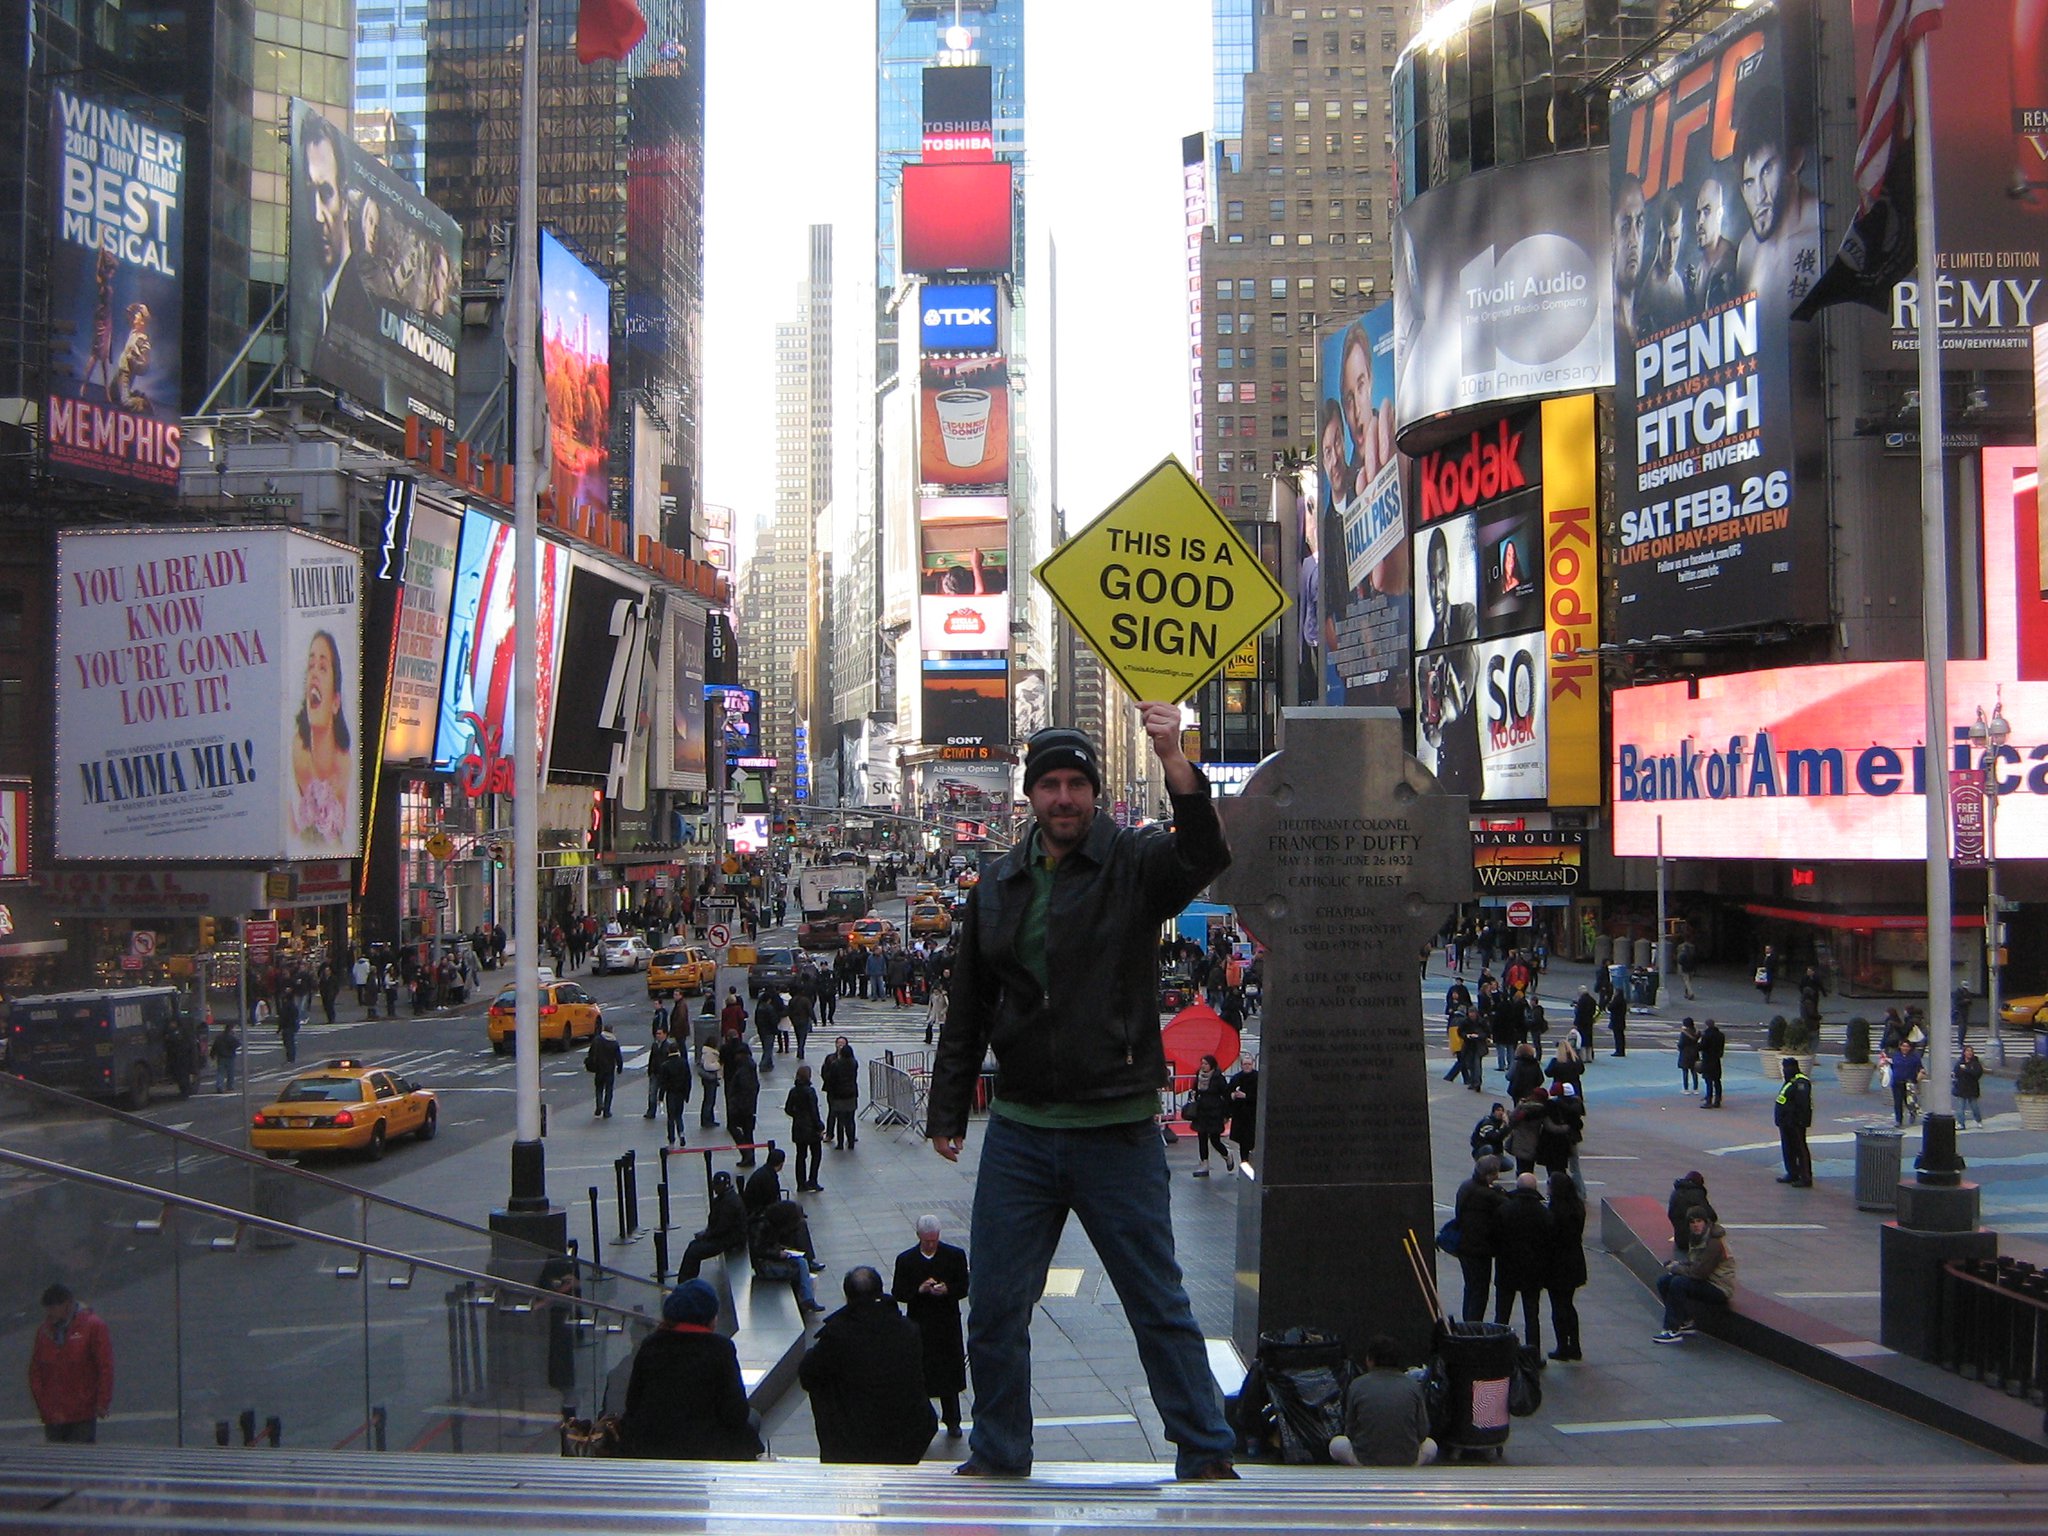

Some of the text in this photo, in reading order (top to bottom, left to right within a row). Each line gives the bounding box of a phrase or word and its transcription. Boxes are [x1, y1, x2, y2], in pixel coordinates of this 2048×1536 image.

[938, 50, 977, 67] 2011
[1737, 52, 1764, 82] 127
[59, 90, 184, 172] WINNER!
[923, 121, 992, 133] TOSHIBA
[1625, 30, 1766, 201] UFC
[65, 130, 178, 193] 2010 TONY AWARD
[922, 137, 992, 150] TOSHIBA
[64, 155, 177, 243] BEST
[353, 160, 442, 237] TAKE BACK YOUR LIFE
[63, 210, 176, 277] MUSICAL
[1950, 252, 1993, 269] LIMITED
[1996, 251, 2040, 268] EDITION
[1465, 314, 1479, 326] The
[1513, 303, 1539, 315] Radio
[1541, 296, 1588, 311] Company
[1466, 271, 1587, 310] Tivoli Audio
[1701, 290, 1758, 321] SHOWDOWN
[1890, 275, 2042, 329] RÉMY
[938, 307, 993, 326] TDK
[380, 307, 457, 377] UNKNOWN
[1635, 299, 1758, 399] PENN
[1460, 364, 1602, 397] 10th Anniversary
[1683, 376, 1701, 395] VS
[47, 394, 181, 469] MEMPHIS
[407, 397, 448, 428] FEBRUARY
[1636, 373, 1760, 466] FITCH
[1703, 428, 1761, 452] SHOWDOWN
[1421, 418, 1526, 522] Kodak
[1638, 459, 1694, 492] BISPING
[1702, 438, 1761, 473] RIVERA
[1345, 511, 1373, 567] HALL
[1371, 480, 1401, 540] PASS
[1620, 501, 1672, 547] SAT.
[1620, 508, 1790, 566] LIVE ON PAY-PER-VIEW
[1106, 527, 1234, 566] THIS IS A
[73, 547, 250, 608] YOU ALREADY
[290, 564, 355, 609] MAMMA MIA!
[1099, 563, 1235, 612] GOOD
[125, 595, 206, 642] KNOW
[1548, 506, 1594, 702] Kodak
[1109, 612, 1218, 660] SIGN
[74, 628, 270, 690] YOU'RE GONNA
[119, 673, 233, 726] LOVE IT!
[1487, 648, 1536, 735] SO
[946, 736, 984, 745] SONY
[79, 738, 257, 806] MAMMA MIA!
[932, 764, 1000, 775] All-New Optima
[1618, 734, 1748, 801] Bank of
[1277, 818, 1411, 832] LIEUTENANT COLONEL
[1956, 802, 1980, 813] FREE
[1958, 813, 1979, 824] WIFI
[1268, 835, 1340, 851] FRANCIS
[1363, 835, 1422, 851] DUFFY
[1473, 832, 1582, 844] MARQUIS
[1277, 855, 1300, 866] MAY
[1372, 855, 1386, 866] 26
[1387, 855, 1414, 867] 1932
[1288, 875, 1403, 888] CATHOLIC PRIEST
[1477, 866, 1580, 887] WONDERLAND
[1315, 906, 1376, 919] CHAPLAIN
[1350, 923, 1404, 935] INFANTRY
